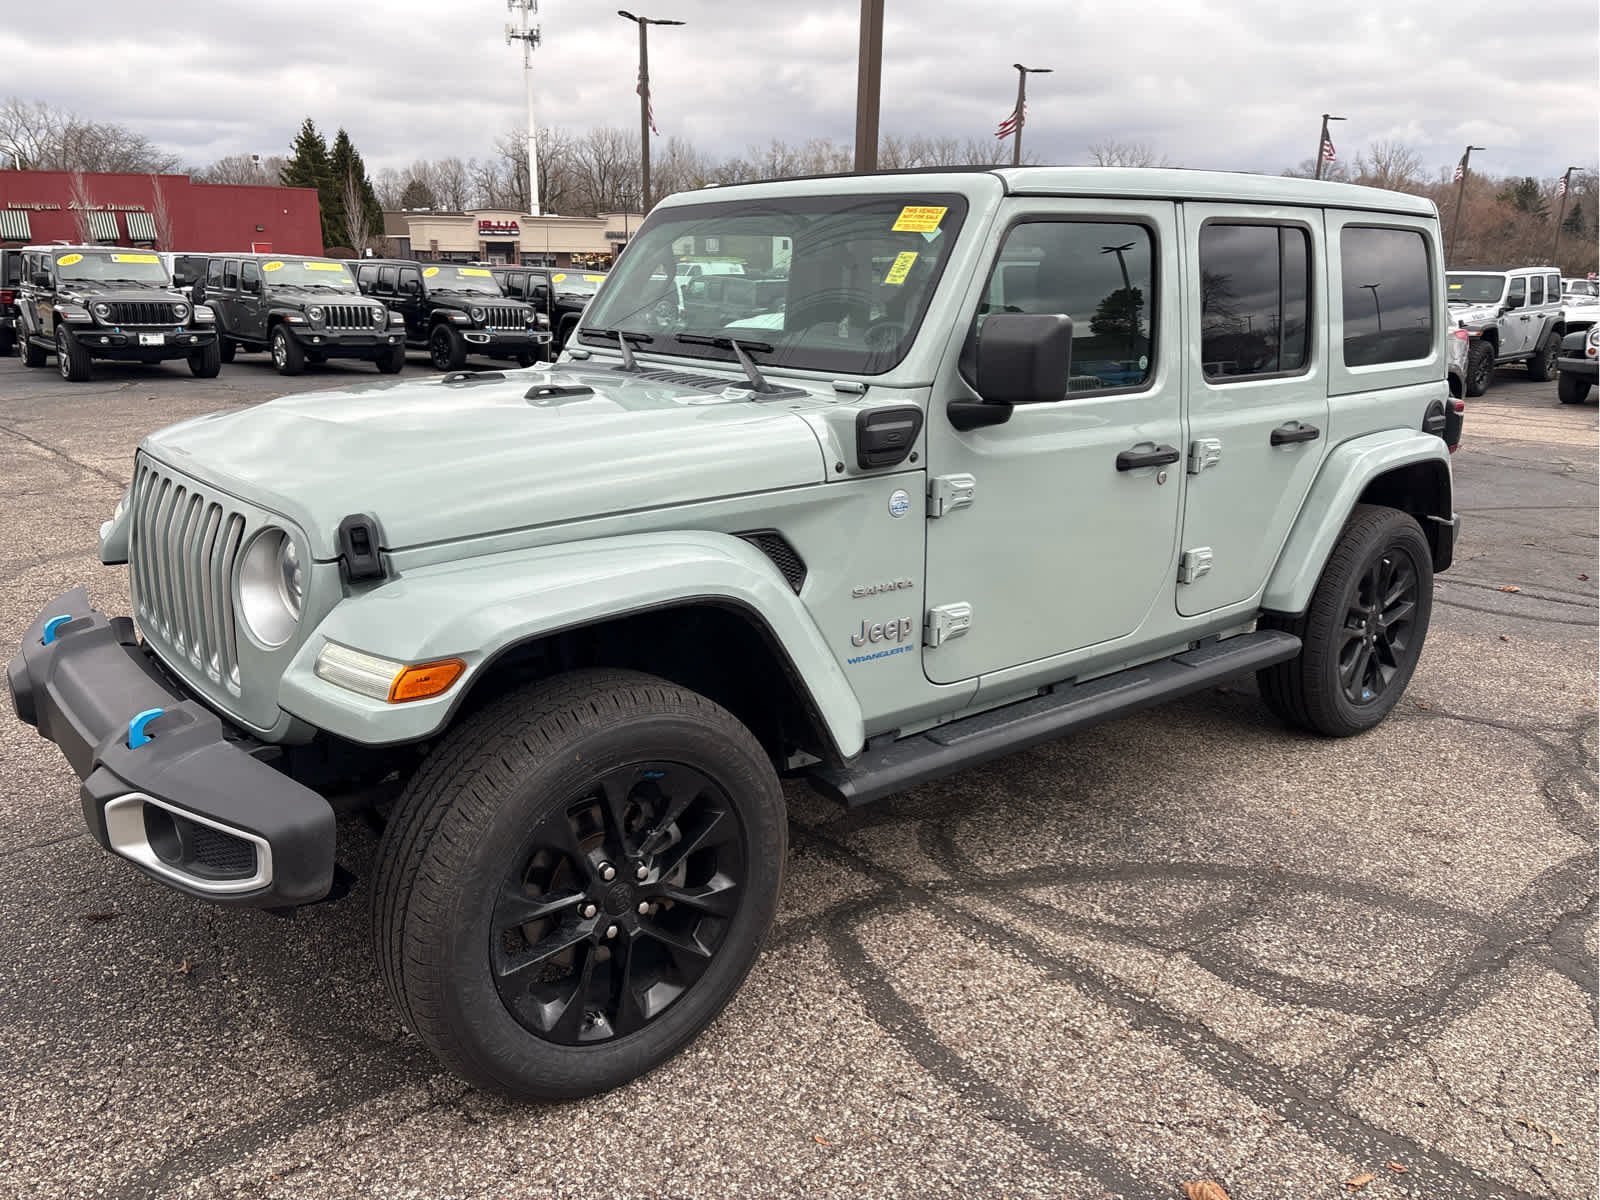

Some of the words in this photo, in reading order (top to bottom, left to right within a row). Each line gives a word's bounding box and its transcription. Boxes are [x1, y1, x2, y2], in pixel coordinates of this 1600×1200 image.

[852, 578, 913, 598] SAHARA
[851, 616, 913, 647] Jeep
[847, 646, 904, 664] WRANGLER
